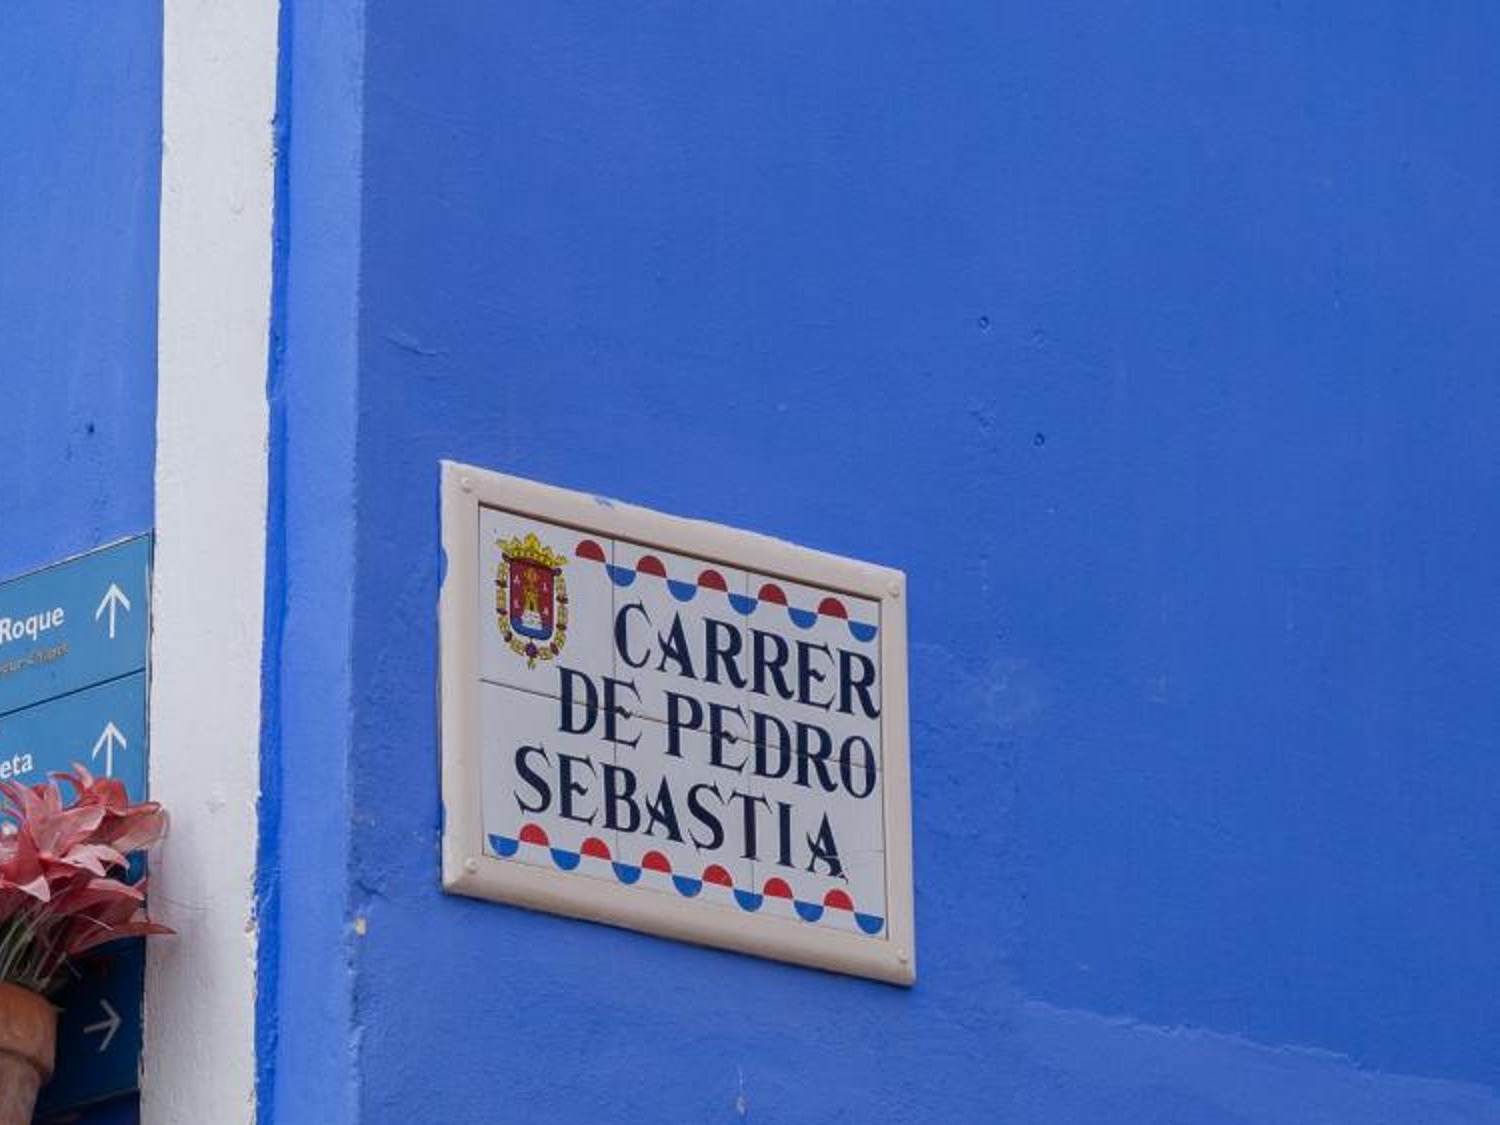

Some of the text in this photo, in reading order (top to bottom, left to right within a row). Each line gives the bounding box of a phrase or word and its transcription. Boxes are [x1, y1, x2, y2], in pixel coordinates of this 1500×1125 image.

[614, 600, 882, 719] CARRER
[556, 665, 878, 800] DE PEDRO
[513, 743, 849, 884] SEBASTIA
